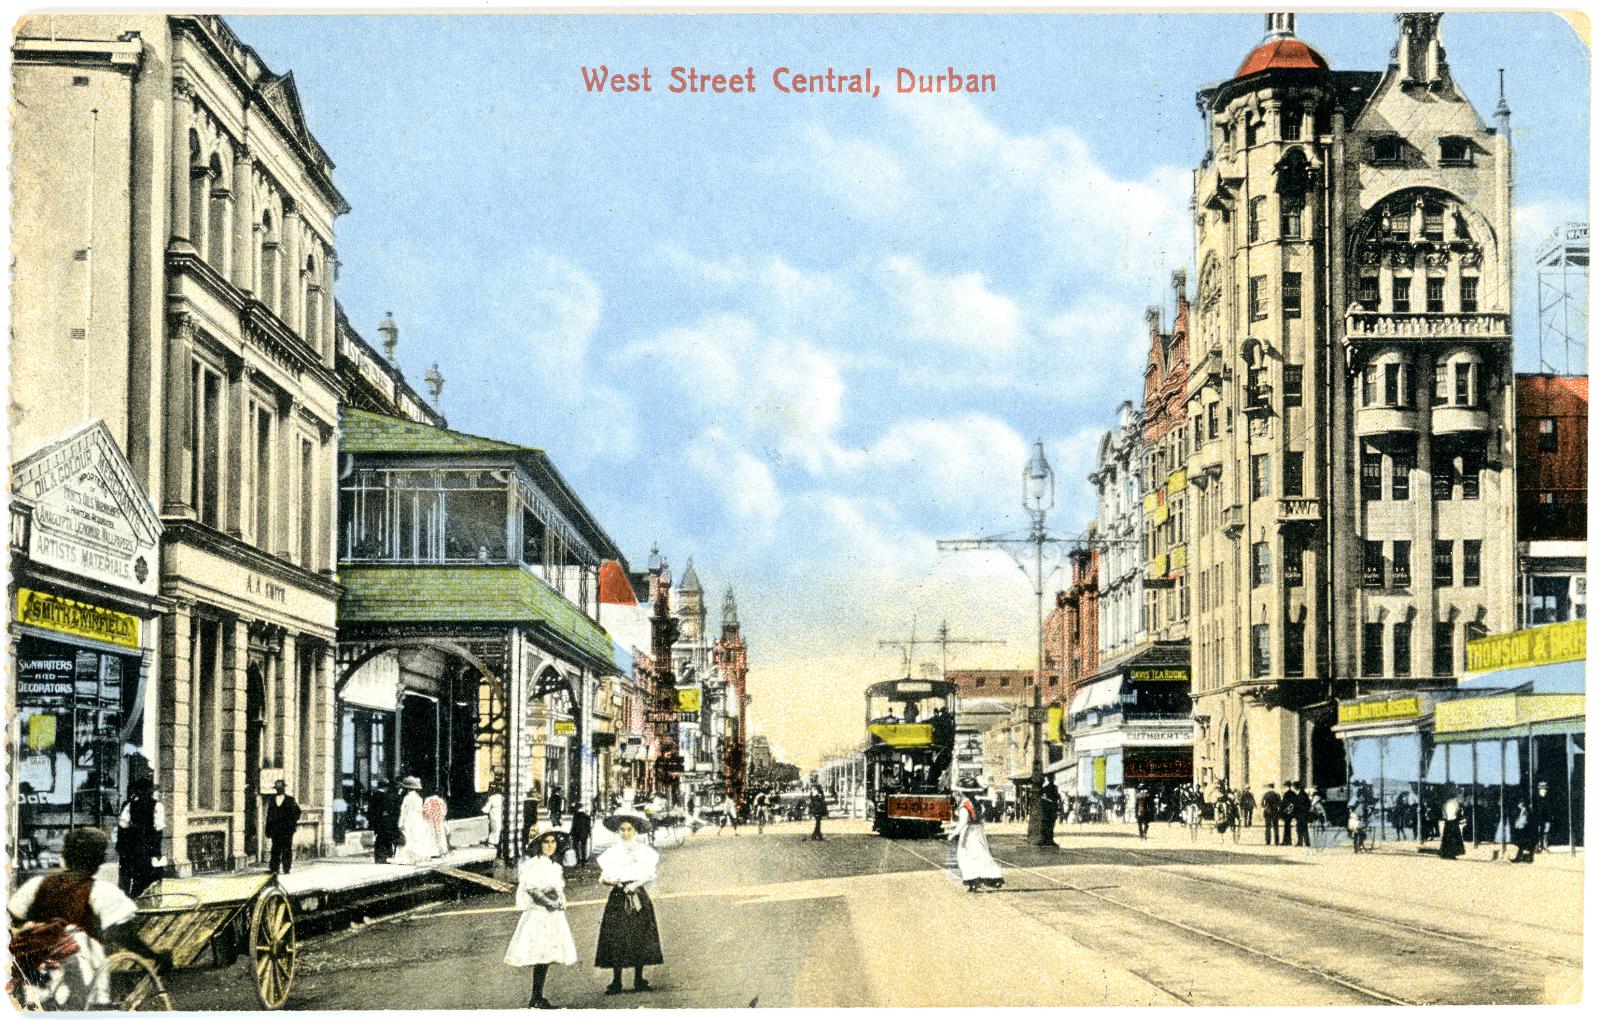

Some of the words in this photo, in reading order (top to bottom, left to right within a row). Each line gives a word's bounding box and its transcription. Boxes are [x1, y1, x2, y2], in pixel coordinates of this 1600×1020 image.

[34, 477, 50, 498] OIL
[58, 448, 92, 483] COLOUR
[37, 535, 77, 562] ARTISTS
[18, 659, 73, 672] SIGNWRITERS
[1466, 634, 1529, 671] THOMSON
[1533, 633, 1546, 661] &
[18, 680, 73, 694] DECORATORS
